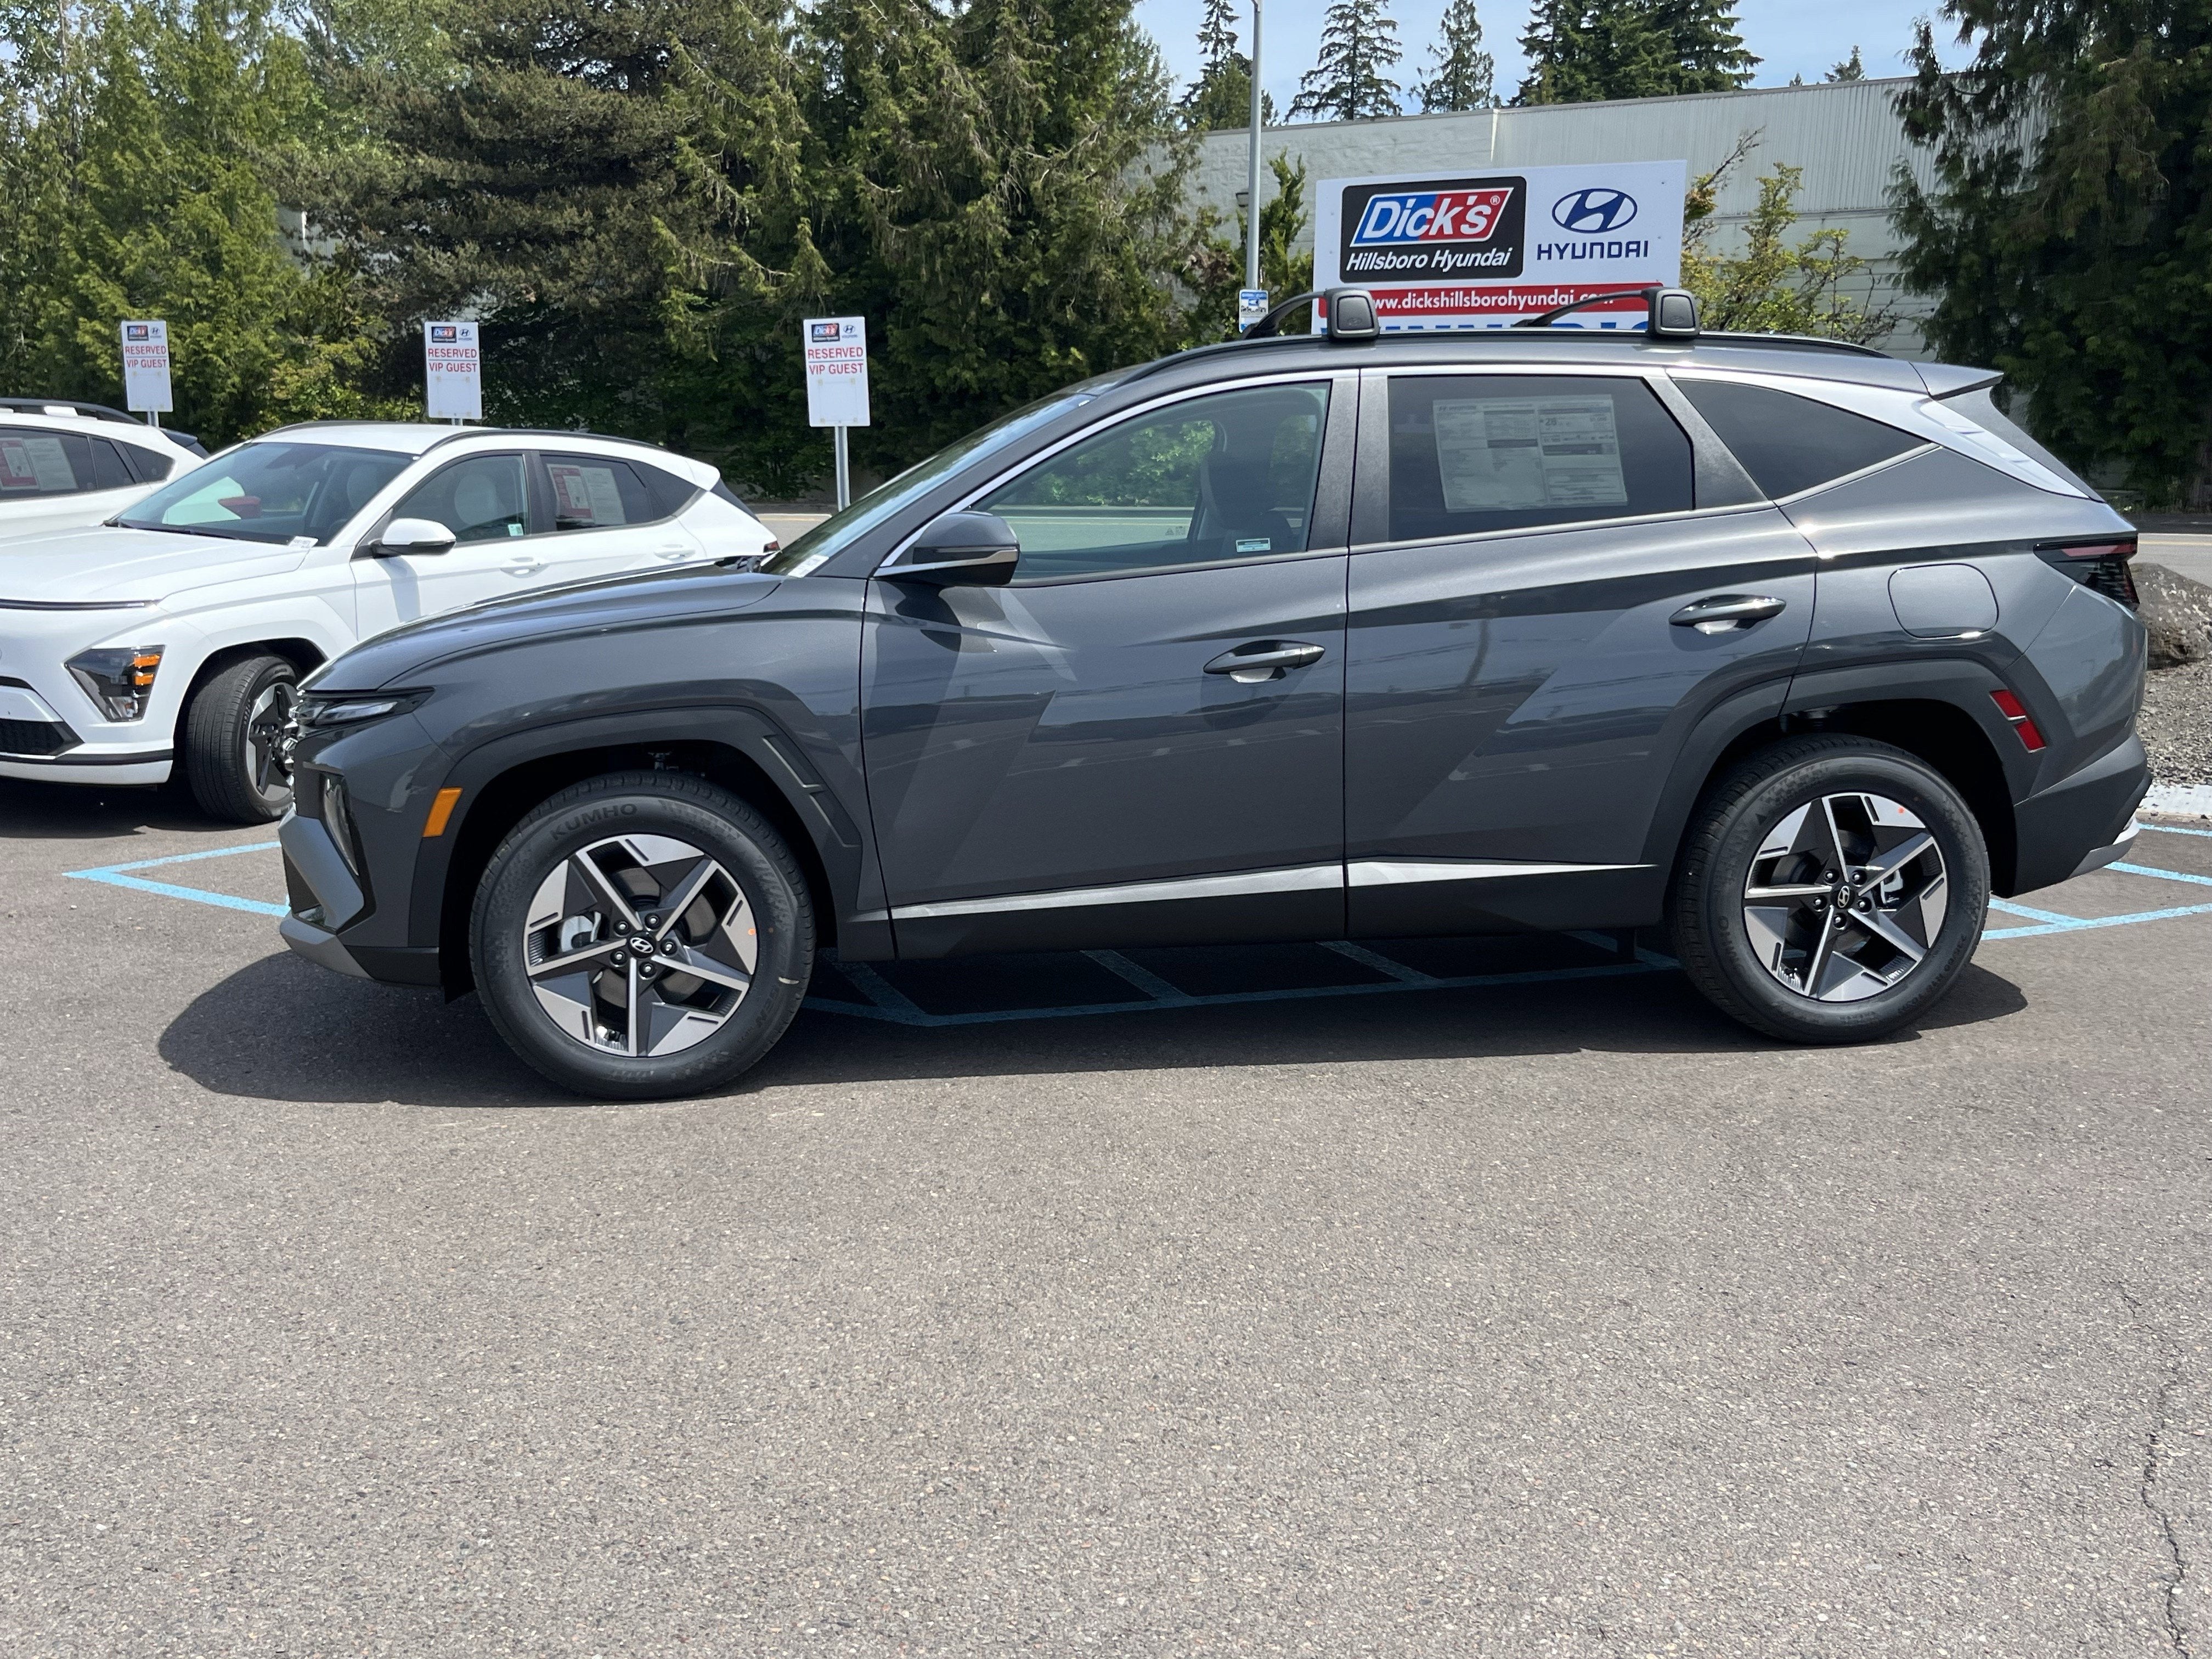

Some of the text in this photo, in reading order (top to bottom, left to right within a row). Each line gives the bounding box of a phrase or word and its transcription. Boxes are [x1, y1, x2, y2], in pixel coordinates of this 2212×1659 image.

[1537, 240, 1649, 261] HYUNDAI
[1346, 247, 1513, 273] Hillsboro Hyundai
[125, 346, 166, 355] RESERVED
[428, 348, 477, 358] RESERVED
[808, 347, 864, 359] RESERVED
[127, 359, 166, 368] VIP GUEST
[429, 363, 477, 373] VIP GUEST
[809, 363, 864, 375] VIP GUEST
[549, 804, 637, 840] KUMHO
